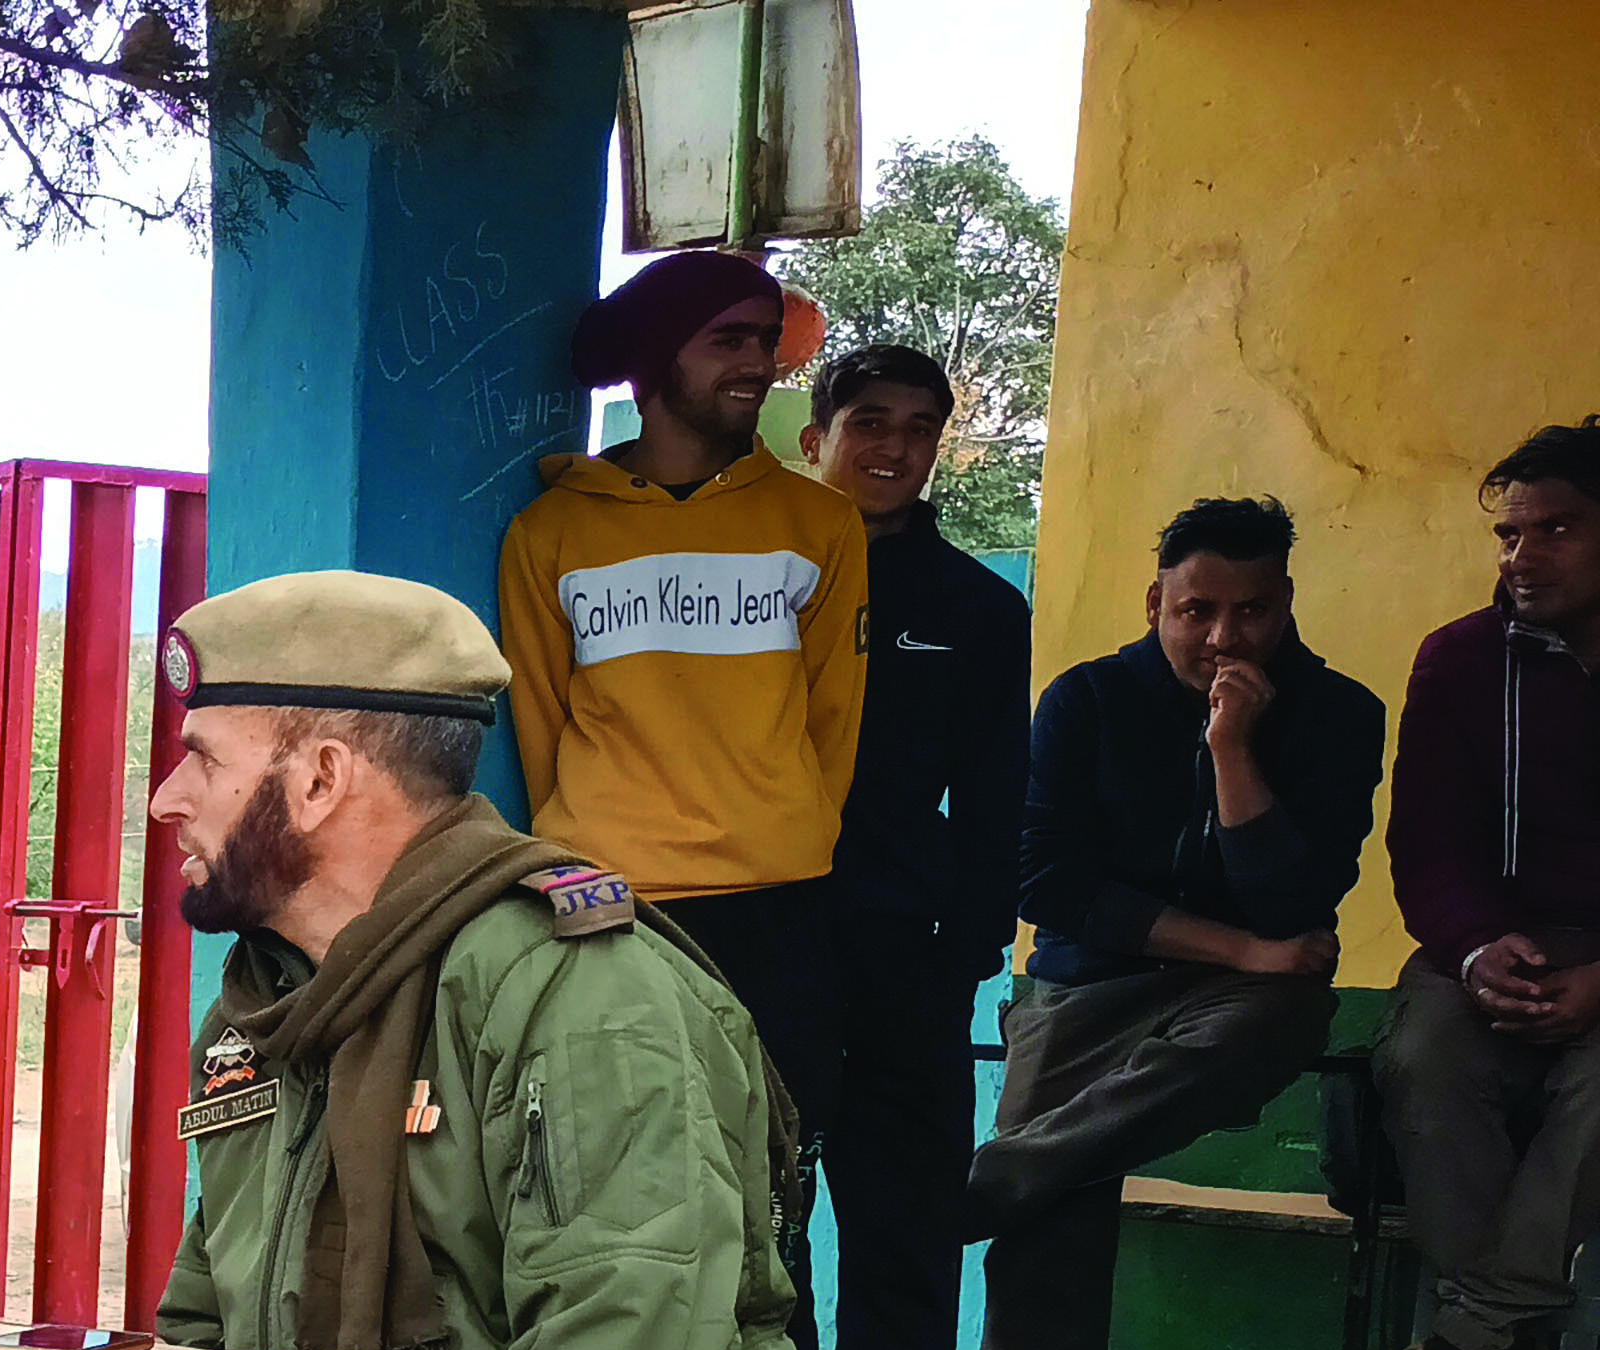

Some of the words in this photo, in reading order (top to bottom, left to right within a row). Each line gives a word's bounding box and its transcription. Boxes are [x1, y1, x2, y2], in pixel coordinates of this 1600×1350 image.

[572, 589, 648, 640] Calvin
[659, 574, 719, 625] Klein
[730, 578, 787, 625] Jean
[560, 881, 629, 916] JKP
[182, 1103, 228, 1131] ABDUL
[231, 1088, 274, 1117] MATIN
